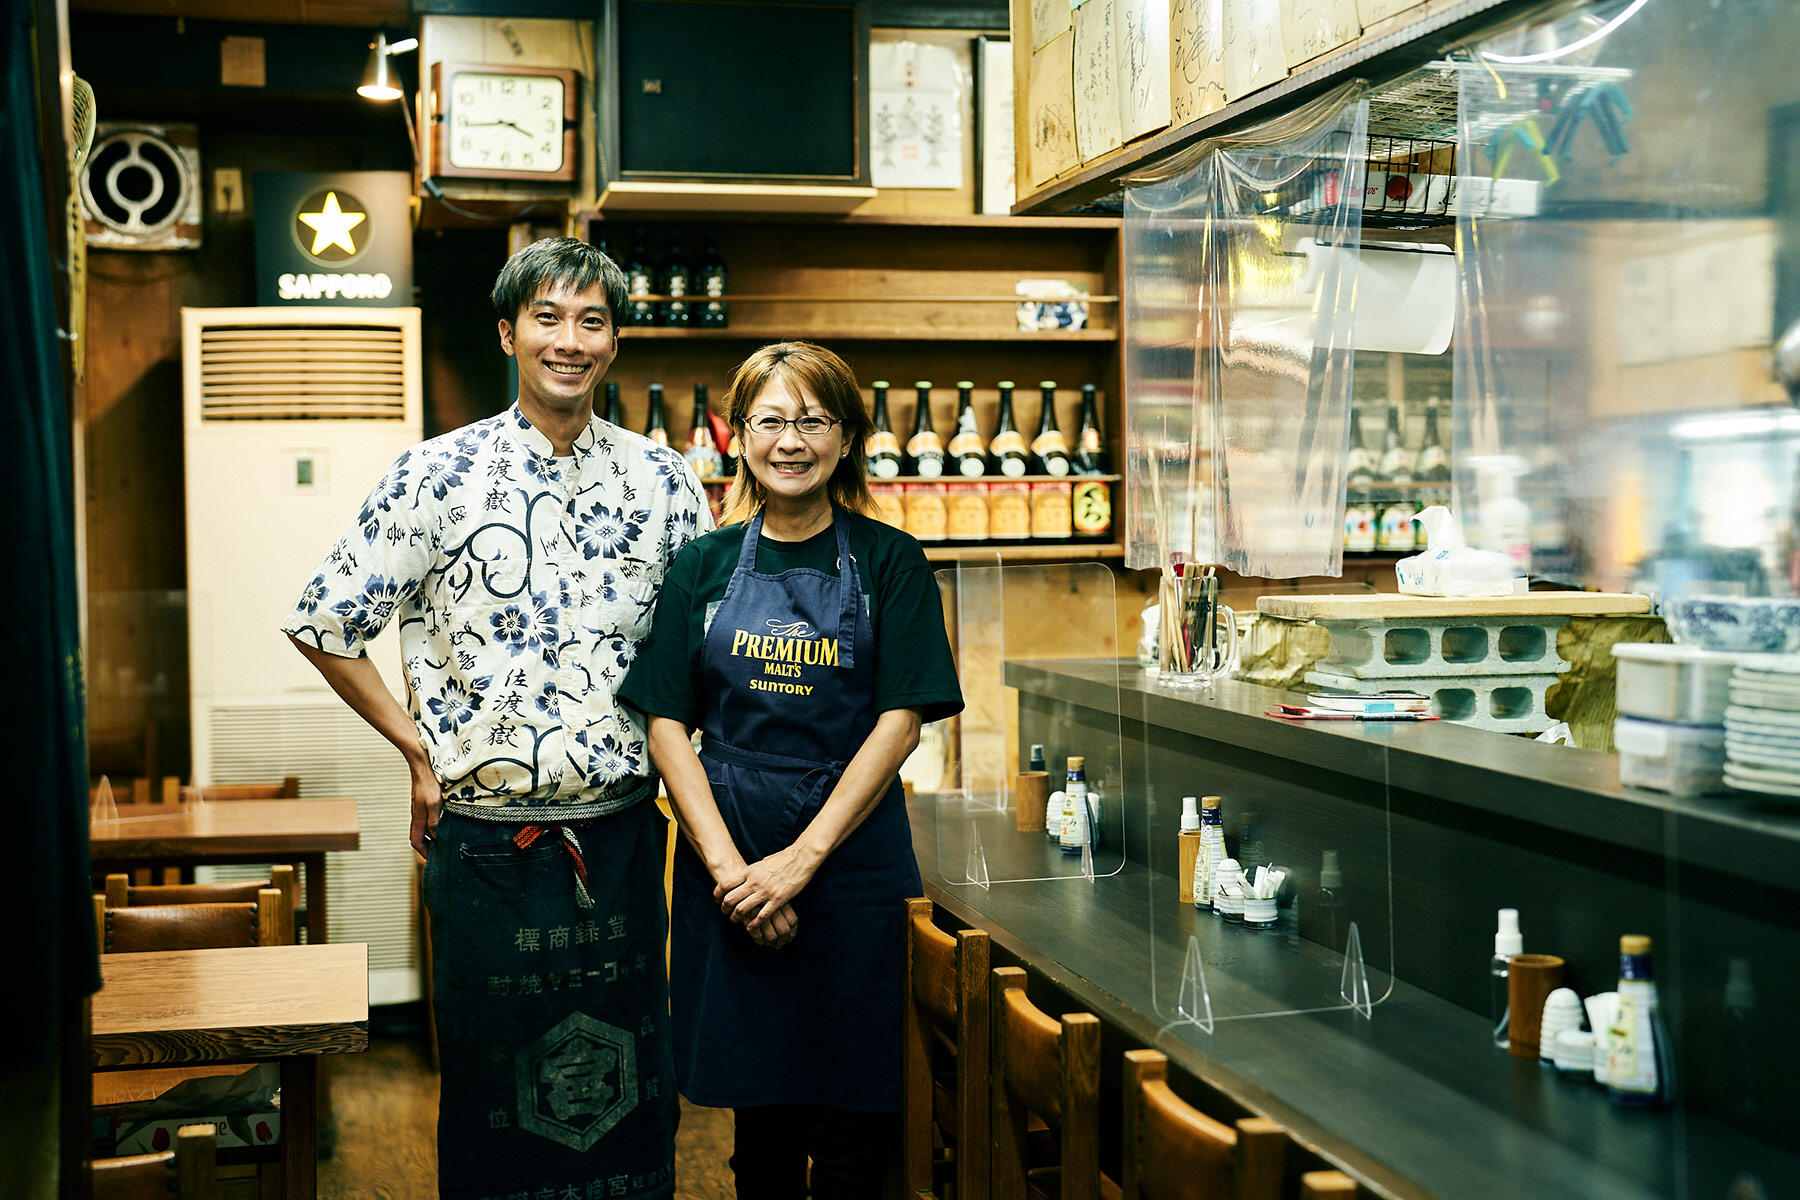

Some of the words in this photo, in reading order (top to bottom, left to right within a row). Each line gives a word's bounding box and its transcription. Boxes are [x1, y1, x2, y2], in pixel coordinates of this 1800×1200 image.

[501, 79, 516, 96] 12
[541, 95, 553, 110] 2
[545, 119, 557, 134] 3
[278, 272, 393, 300] SAPPORO
[765, 618, 816, 638] The
[730, 629, 840, 667] PREMIUM
[763, 662, 802, 678] MALT'S
[749, 679, 814, 696] SUNTORY
